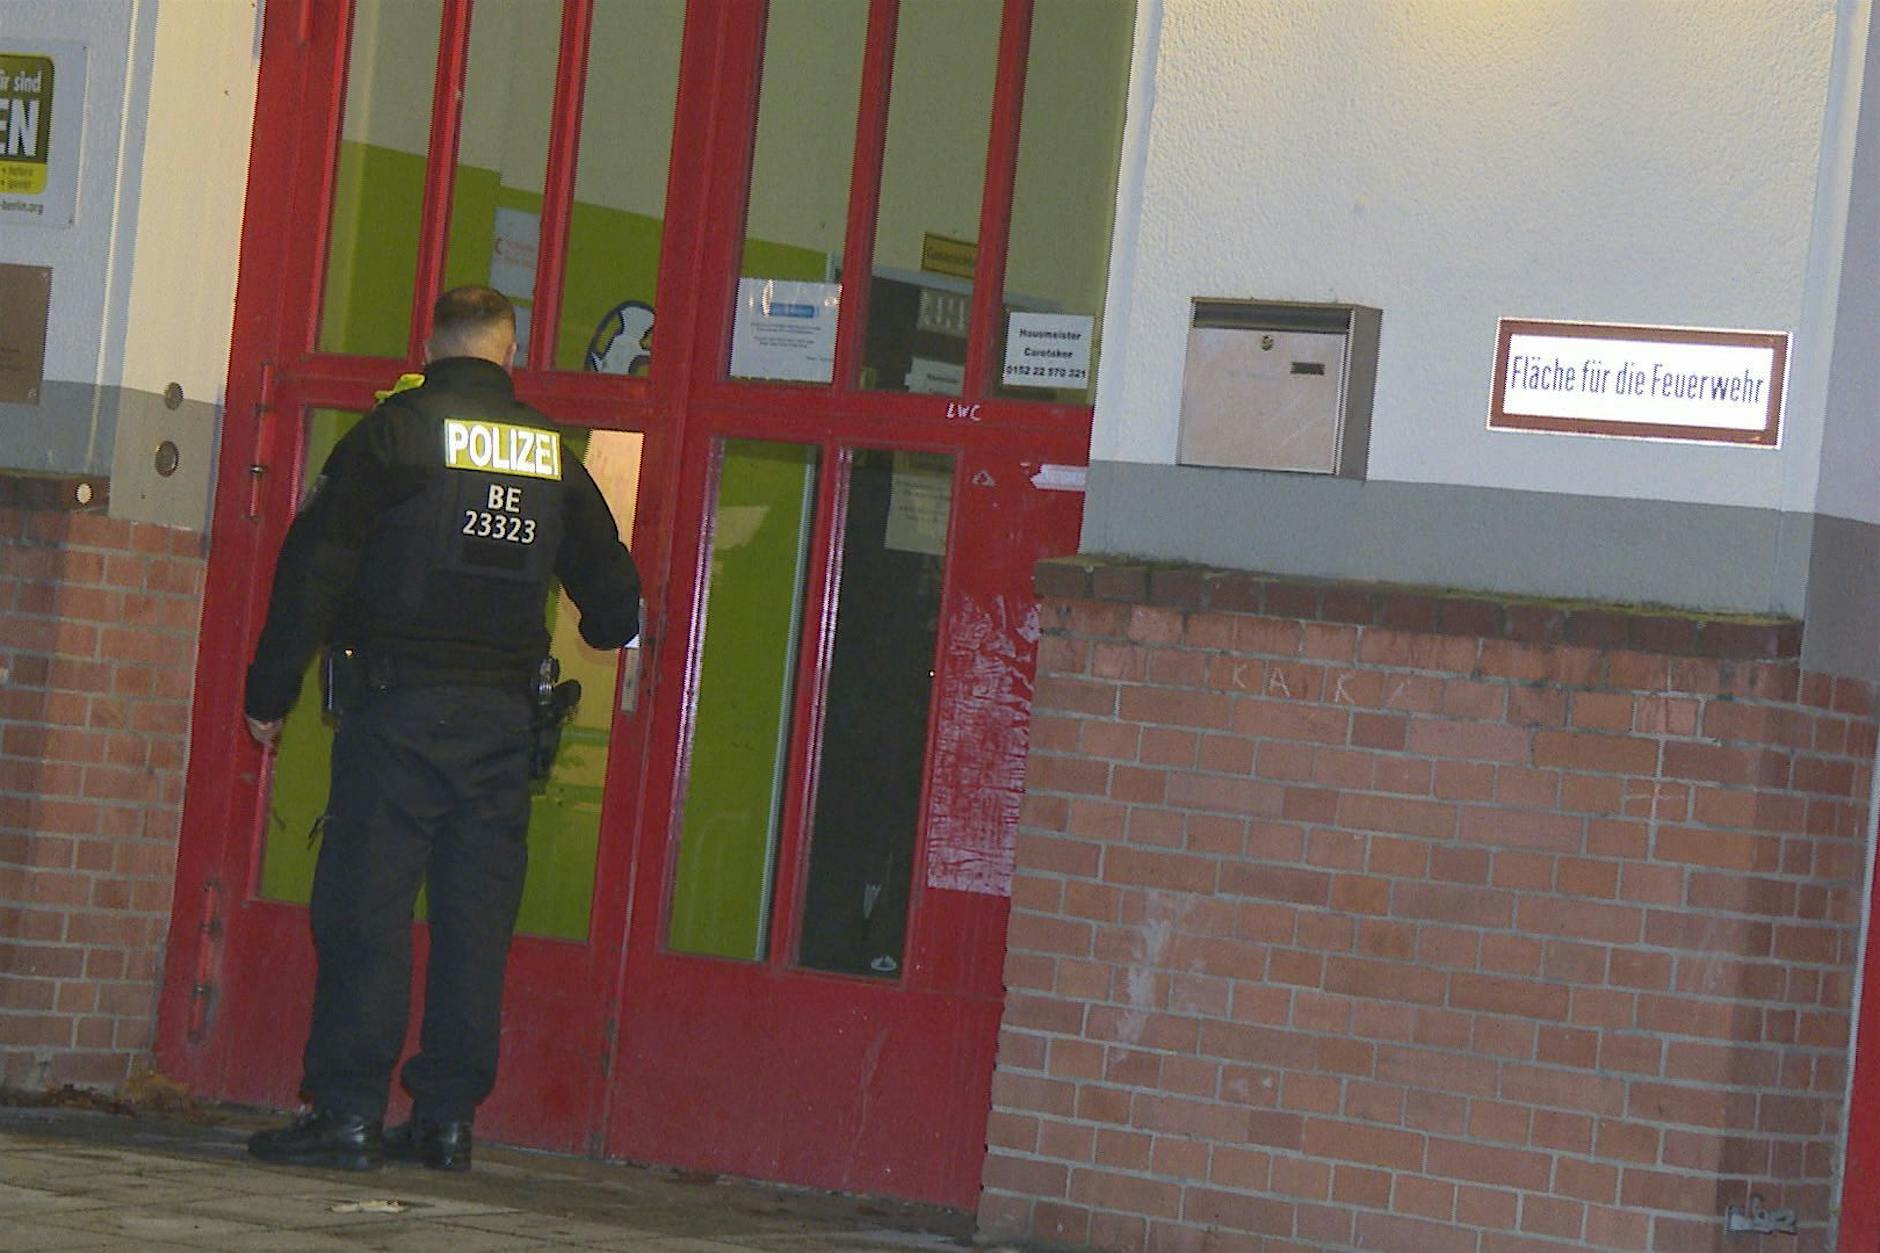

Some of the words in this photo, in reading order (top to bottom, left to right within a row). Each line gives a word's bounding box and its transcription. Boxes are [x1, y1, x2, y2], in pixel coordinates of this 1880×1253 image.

[14, 70, 42, 92] sind
[1019, 328, 1082, 340] Hausmeister
[1024, 347, 1073, 358] Caretaker
[1511, 355, 1576, 391] Fläche
[1581, 359, 1611, 393] für
[1615, 360, 1646, 396] die
[1651, 363, 1764, 403] Feuerwehr
[448, 422, 559, 475] POLIZEI
[487, 484, 522, 513] BE
[462, 510, 536, 544] 23323
